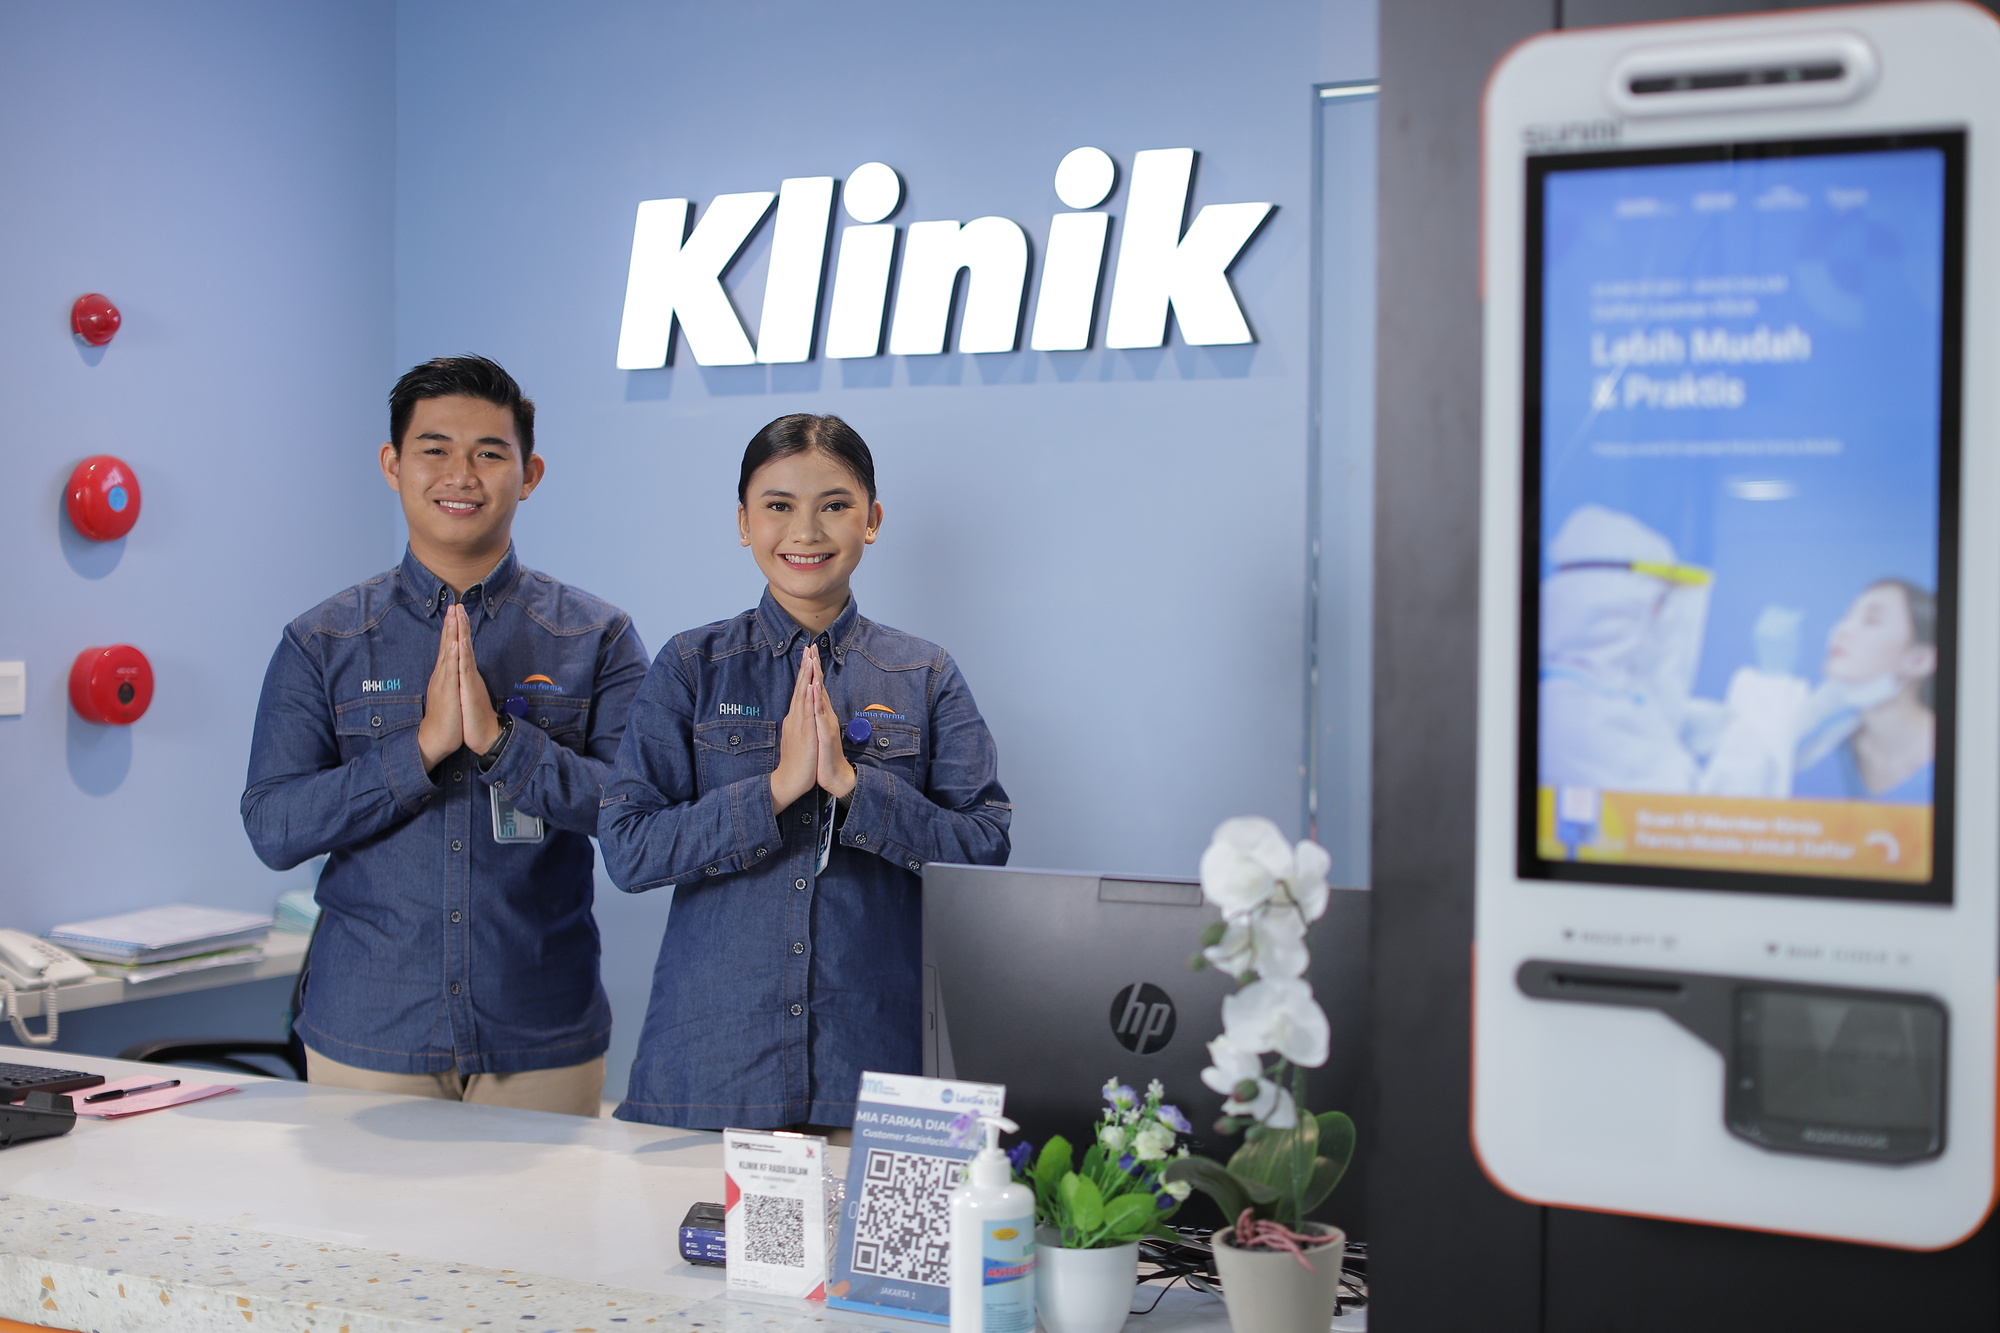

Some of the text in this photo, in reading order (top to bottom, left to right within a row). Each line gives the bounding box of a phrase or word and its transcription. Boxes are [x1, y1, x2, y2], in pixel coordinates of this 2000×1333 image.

[616, 146, 1277, 371] Klinik
[1593, 325, 1809, 366] Lebih Mudah
[1624, 373, 1745, 409] Praktis
[1117, 982, 1171, 1054] hp
[862, 1128, 903, 1142] Customer
[880, 1113, 923, 1130] FARMA
[880, 1286, 910, 1299] JAKARTA
